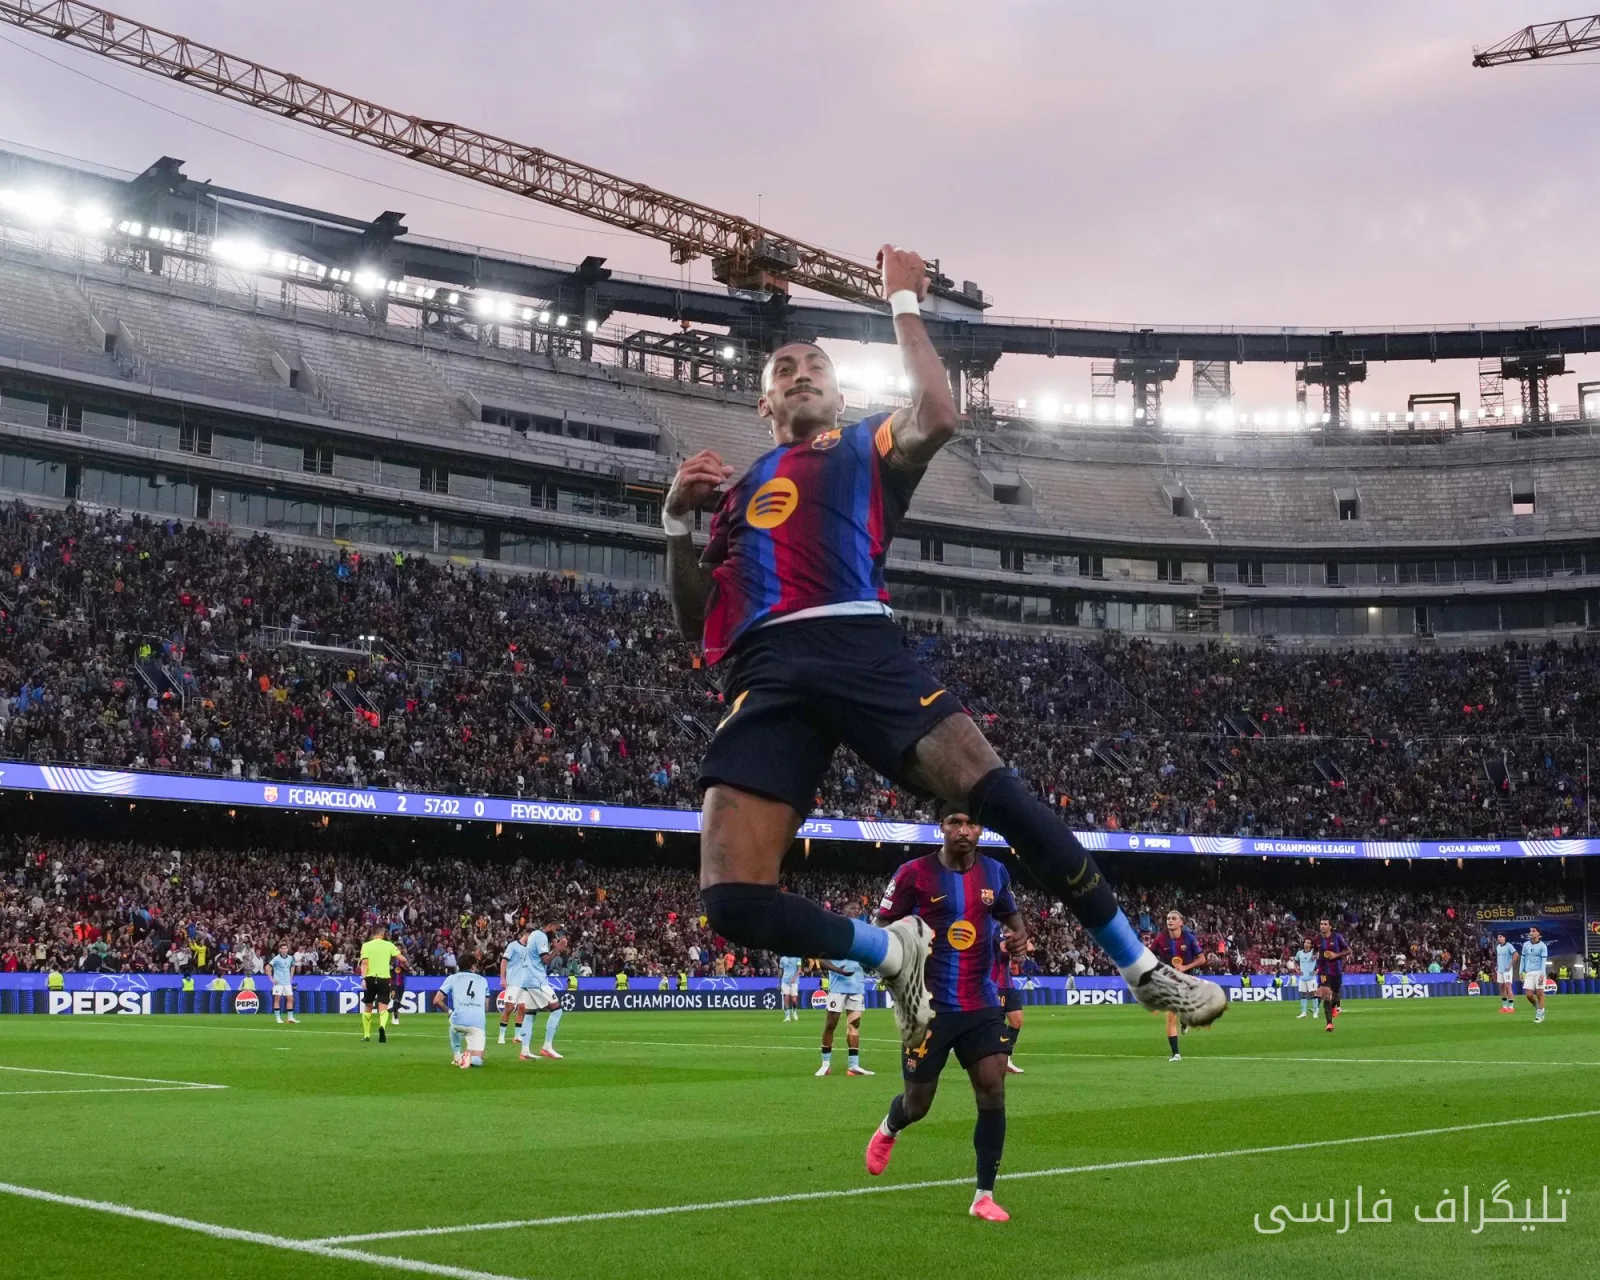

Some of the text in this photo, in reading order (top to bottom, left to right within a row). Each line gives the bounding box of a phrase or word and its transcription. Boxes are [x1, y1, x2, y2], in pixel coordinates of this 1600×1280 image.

[288, 788, 377, 810] FC BARCELONA
[397, 796, 407, 812] 2
[424, 798, 460, 815] 57:02
[474, 800, 484, 817] 0
[511, 803, 583, 822] FEYENOORD
[803, 822, 833, 833] PS5
[1254, 842, 1356, 854] UEFA CHAMPIONS LEAGUE
[1438, 844, 1501, 854] QATAR AIRWAYS
[1475, 907, 1515, 920] SOSES
[466, 980, 476, 1000] 4
[1065, 989, 1123, 1005] PEPSI
[1229, 987, 1282, 1002] PEPSI
[1381, 984, 1430, 999] PEPSI
[49, 991, 151, 1015] PEPSI
[236, 1000, 258, 1008] PEPSI
[339, 991, 426, 1014] PSI
[583, 994, 756, 1009] UEFA CHAMPIONS LEAGUE
